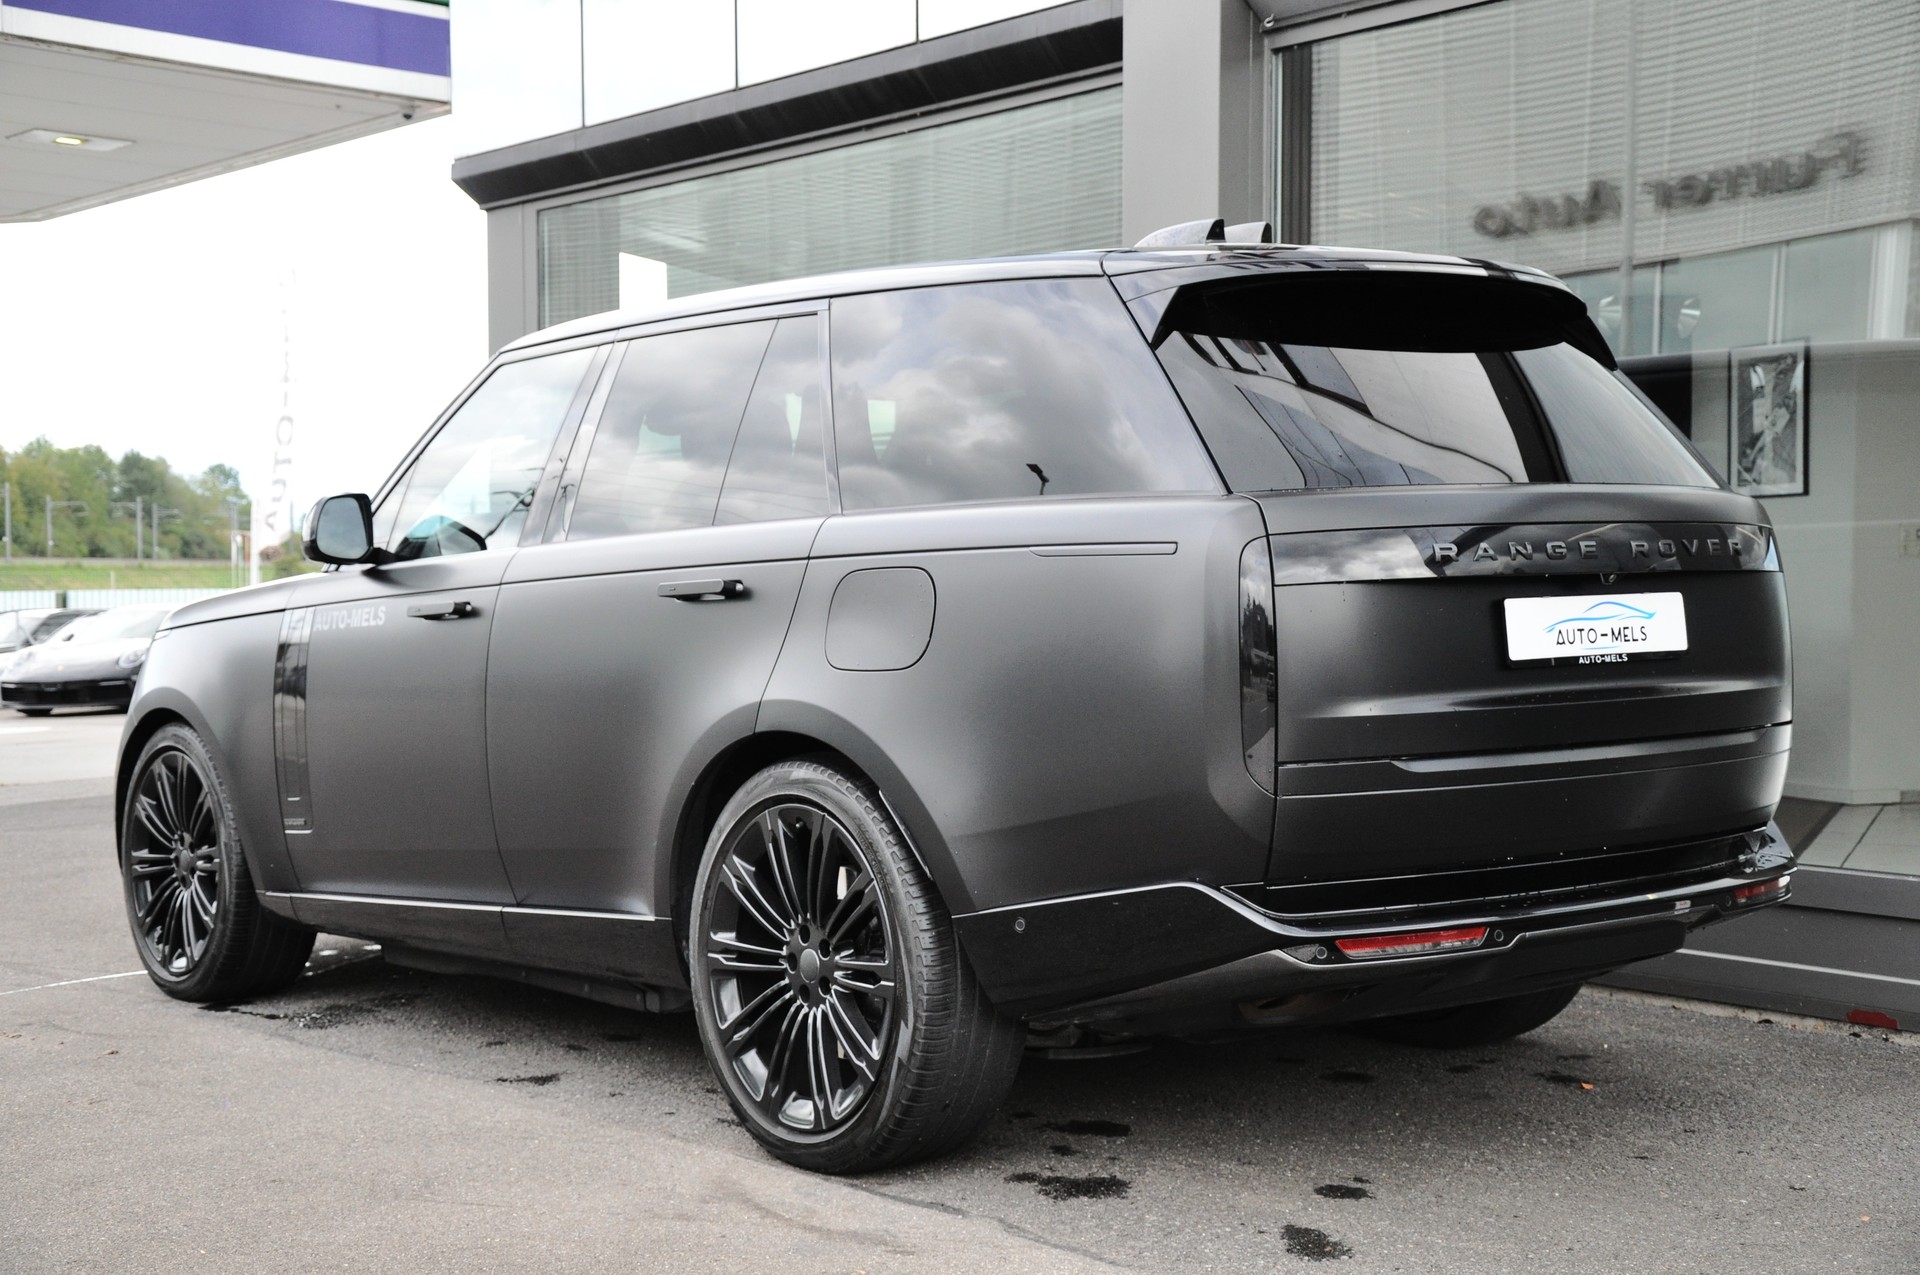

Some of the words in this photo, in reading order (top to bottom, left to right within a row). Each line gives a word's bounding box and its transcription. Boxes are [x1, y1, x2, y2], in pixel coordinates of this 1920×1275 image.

[1432, 539, 1600, 563] RANGE
[1630, 537, 1743, 558] ROVER
[313, 605, 387, 632] AUTO-MELS
[1556, 626, 1648, 645] AUTO-MELS
[1578, 653, 1628, 664] AUTO-MELS
